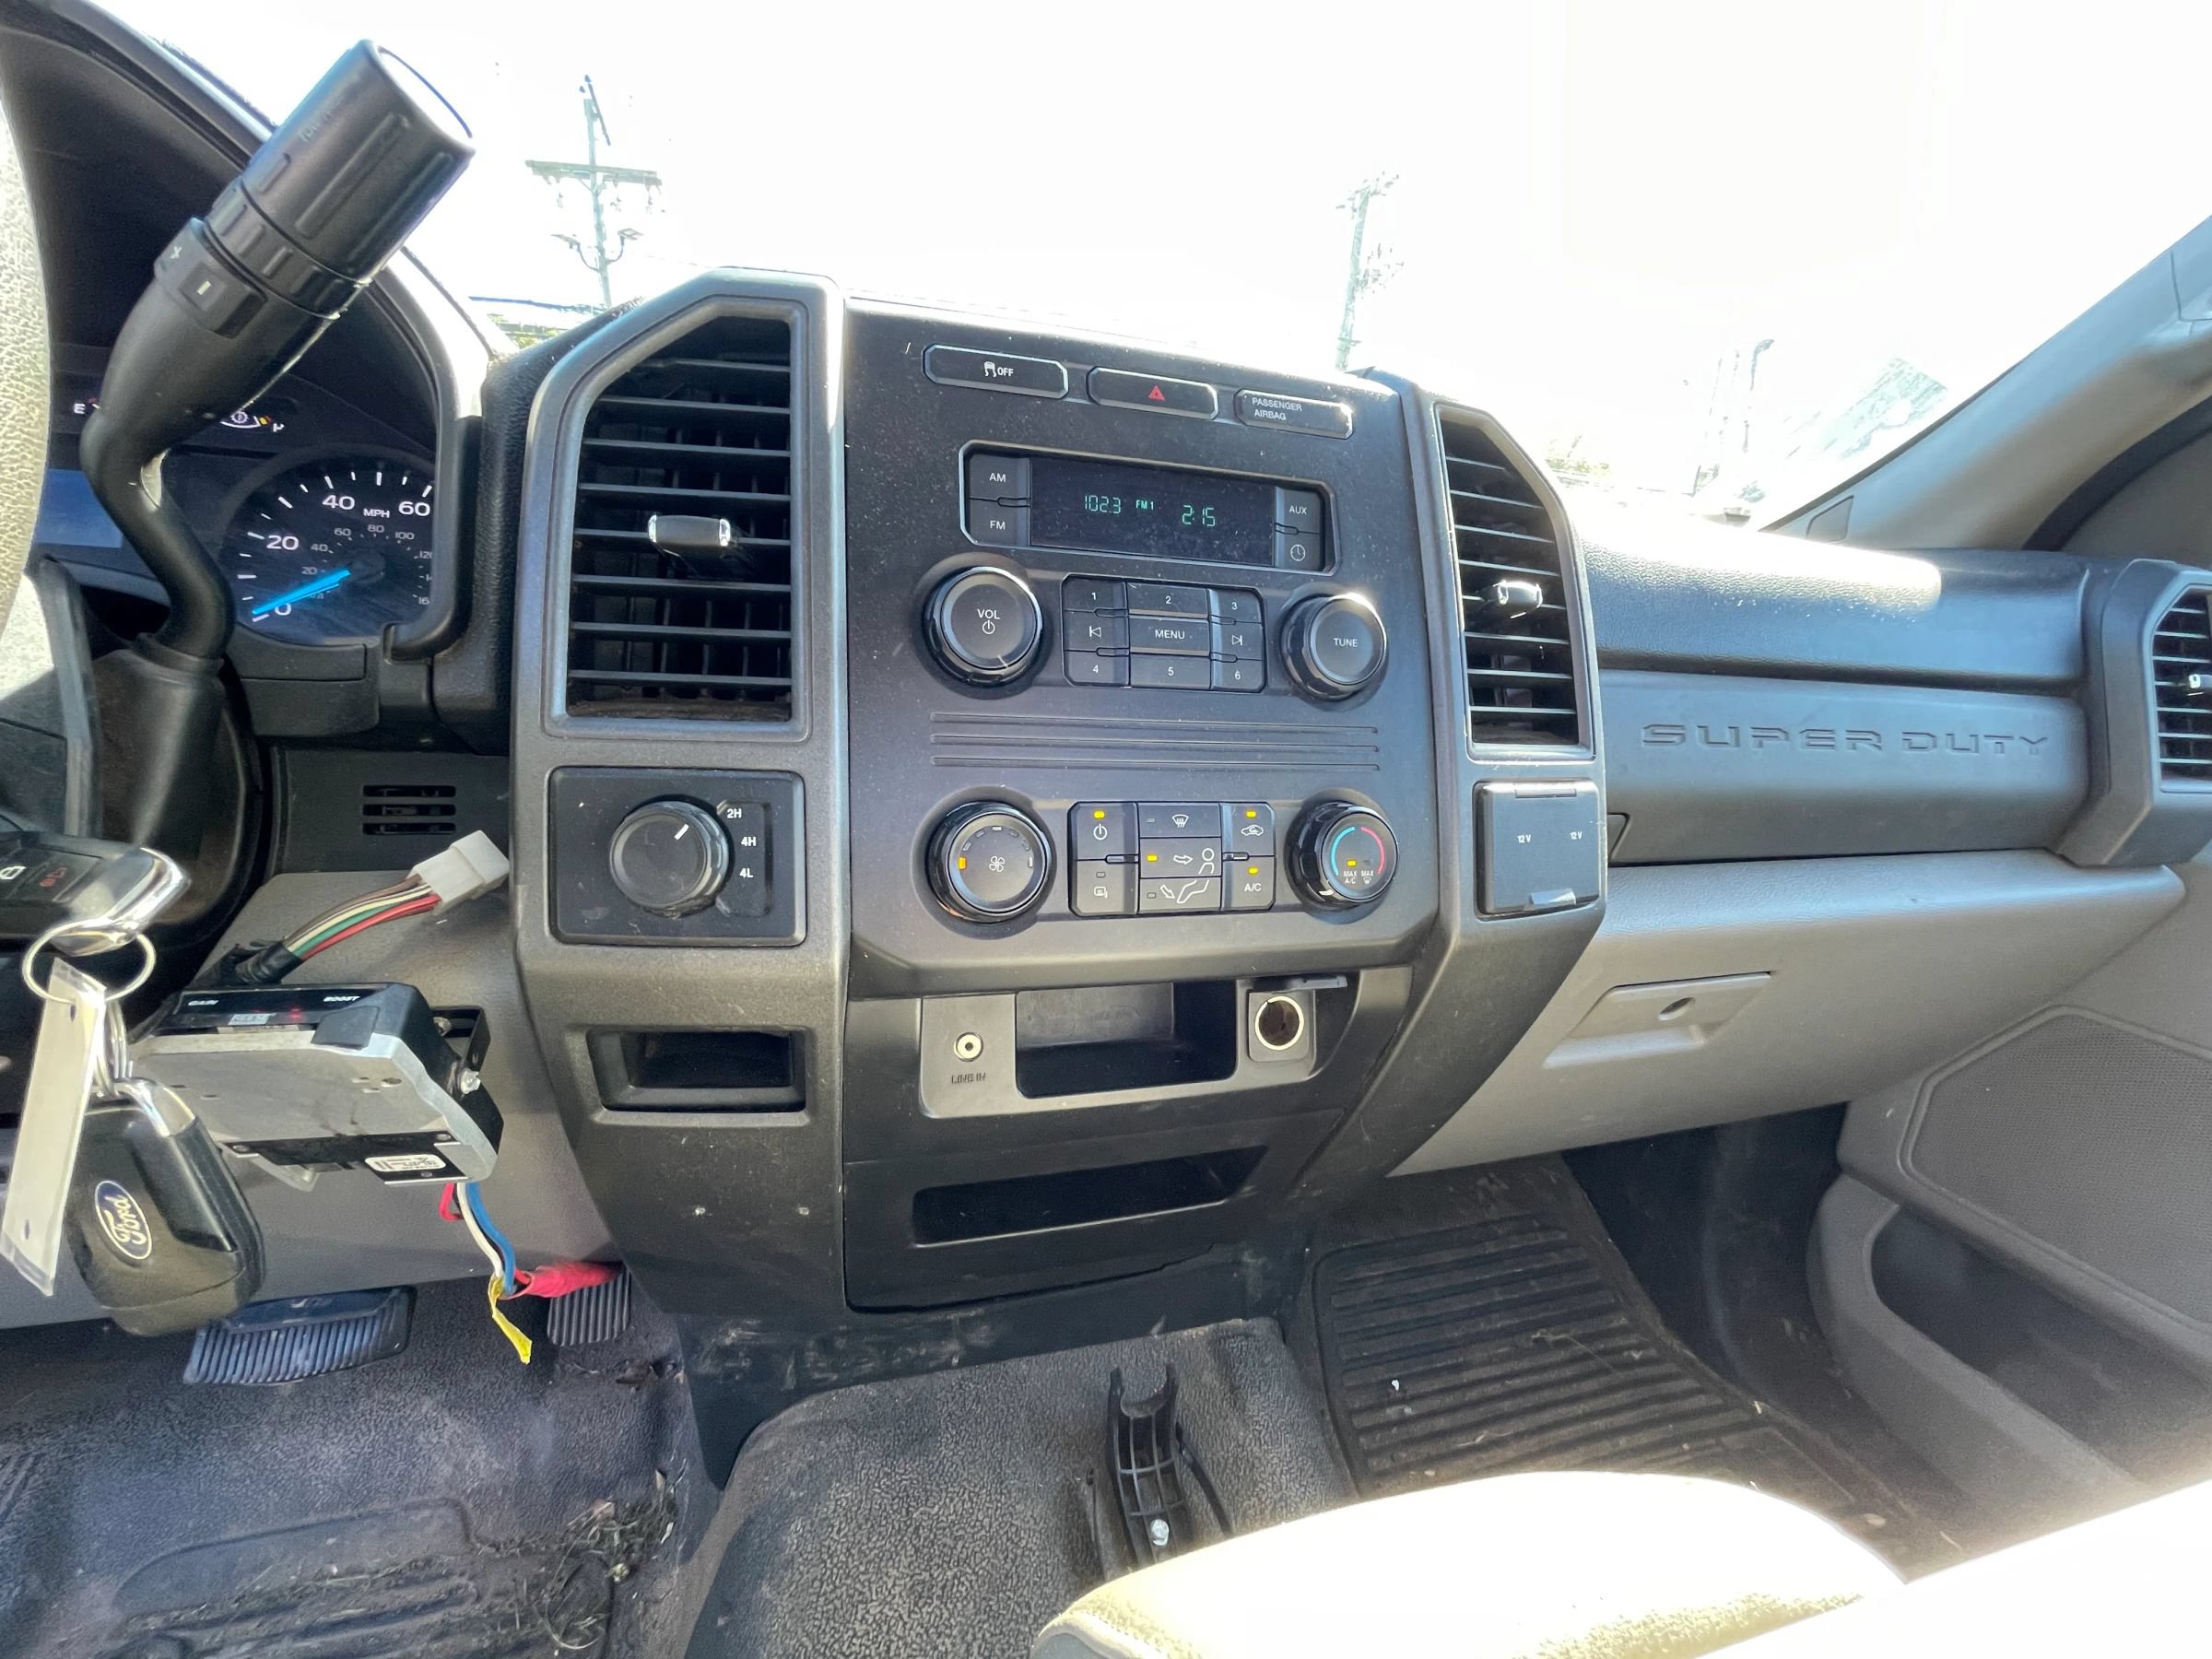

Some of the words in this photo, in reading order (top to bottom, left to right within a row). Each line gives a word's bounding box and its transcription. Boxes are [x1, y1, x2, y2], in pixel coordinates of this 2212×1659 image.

[997, 367, 1014, 377] OFF
[73, 403, 86, 415] E
[1252, 397, 1302, 412] PASSENGER
[1253, 409, 1287, 420] AIRBAG
[989, 472, 1006, 483] AM
[323, 494, 356, 511] 40
[362, 507, 391, 519] MPH
[398, 500, 431, 517] 60
[1288, 505, 1308, 515] AUX
[1182, 504, 1216, 527] 2:15
[367, 524, 385, 534] 80
[989, 520, 1006, 531] FM
[333, 527, 352, 537] 60
[394, 531, 415, 541] 100
[266, 534, 300, 551] 20
[310, 543, 329, 553] 40
[301, 566, 318, 576] 20
[1090, 591, 1097, 601] 1
[1165, 595, 1172, 605] 2
[274, 602, 292, 617] 0
[1231, 602, 1239, 611] 3
[977, 608, 1001, 620] VOL
[1154, 629, 1185, 641] MENU
[1333, 637, 1359, 648] TUNE
[1092, 664, 1100, 674] 4
[1167, 666, 1175, 677] 5
[1234, 671, 1241, 680] 6
[1642, 724, 1883, 752] SUPER
[1900, 731, 2049, 757] DUTY
[726, 807, 742, 818] 2H
[740, 836, 757, 847] 4H
[739, 867, 754, 878] 4L
[1344, 877, 1357, 885] A/C
[1243, 881, 1262, 893] A/C
[951, 1073, 974, 1084] LINE
[976, 1072, 986, 1082] IN
[103, 1194, 147, 1245] Ford
